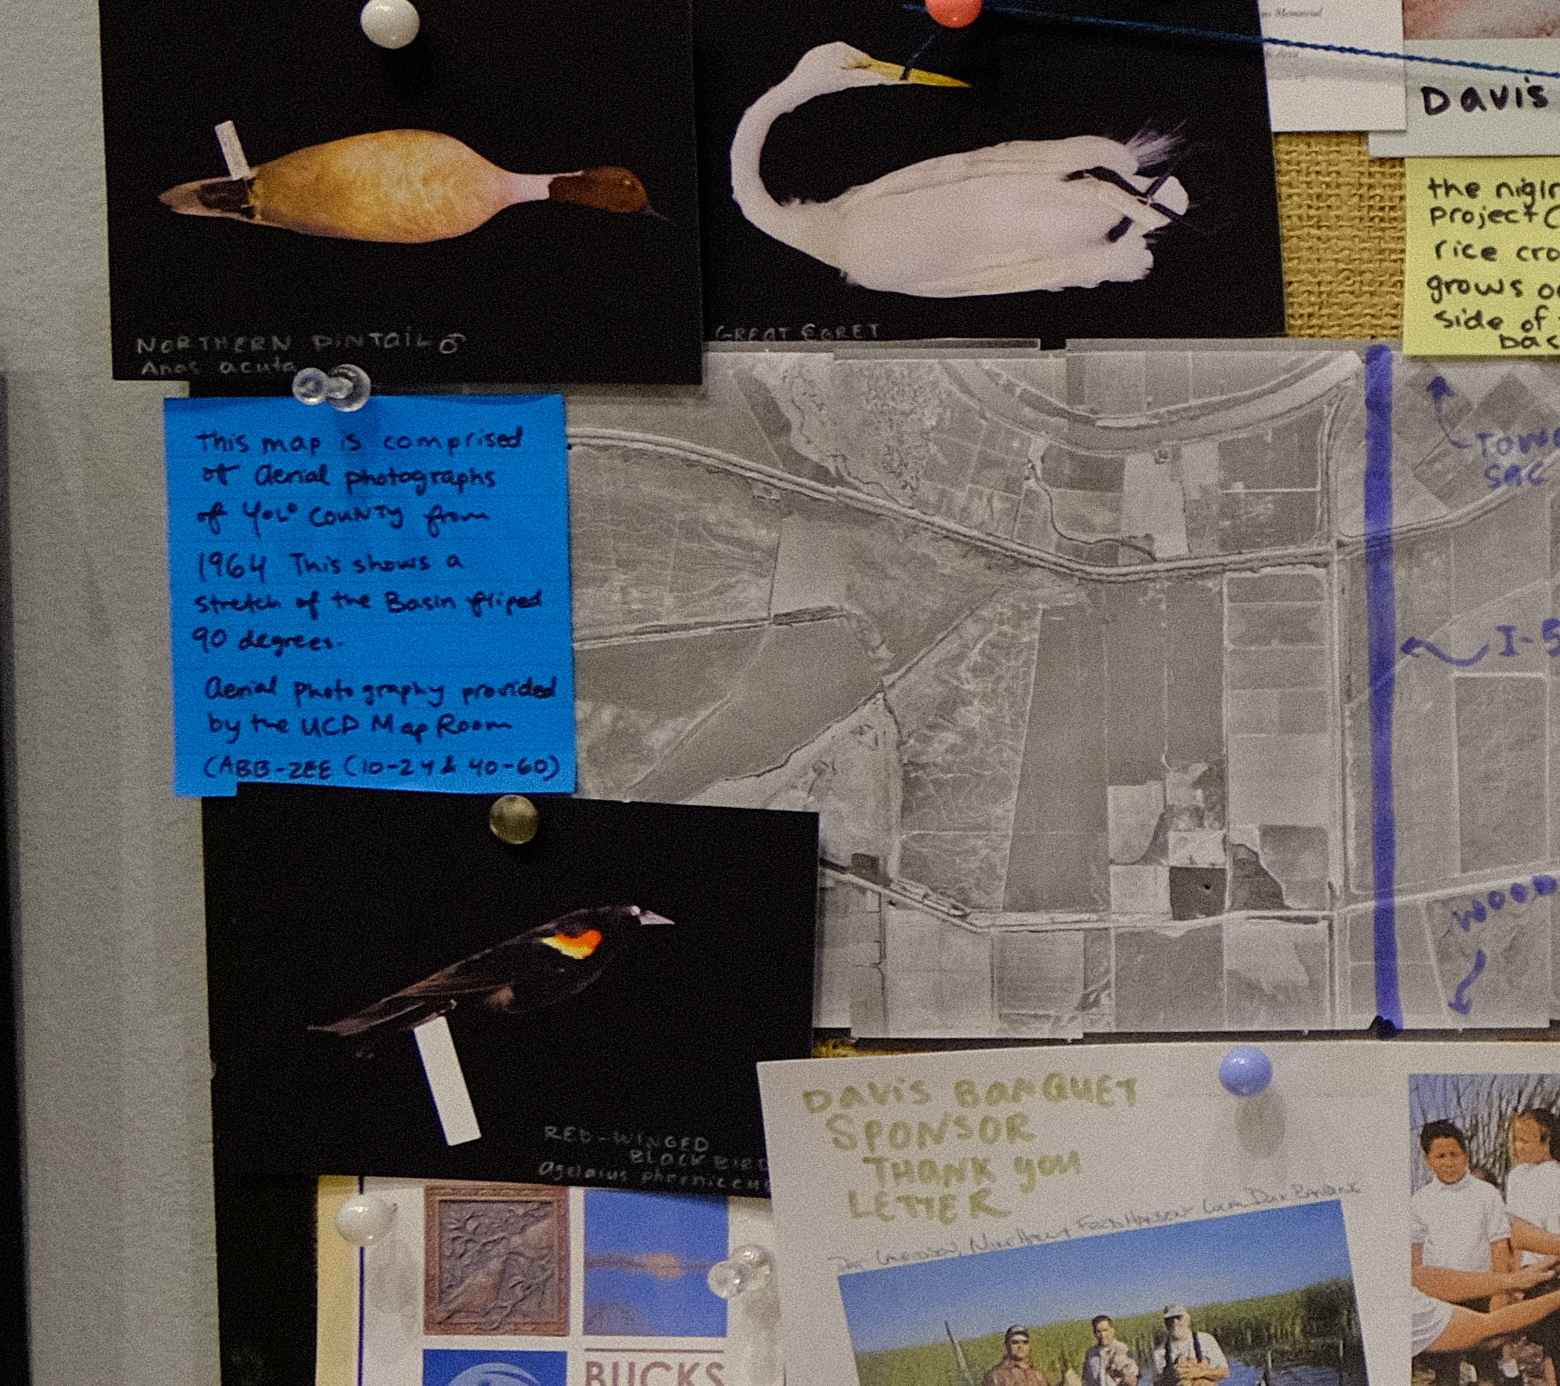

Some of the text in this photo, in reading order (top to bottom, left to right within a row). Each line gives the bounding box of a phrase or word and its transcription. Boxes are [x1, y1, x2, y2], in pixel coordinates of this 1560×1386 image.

[1427, 177, 1481, 198] the
[1435, 242, 1498, 261] rice
[1426, 276, 1524, 304] grows
[1435, 309, 1504, 331] side
[1521, 305, 1549, 332] of
[199, 553, 463, 581] 1964 This shows a
[191, 627, 226, 651] 90
[826, 1113, 1037, 1152] SPONSOR
